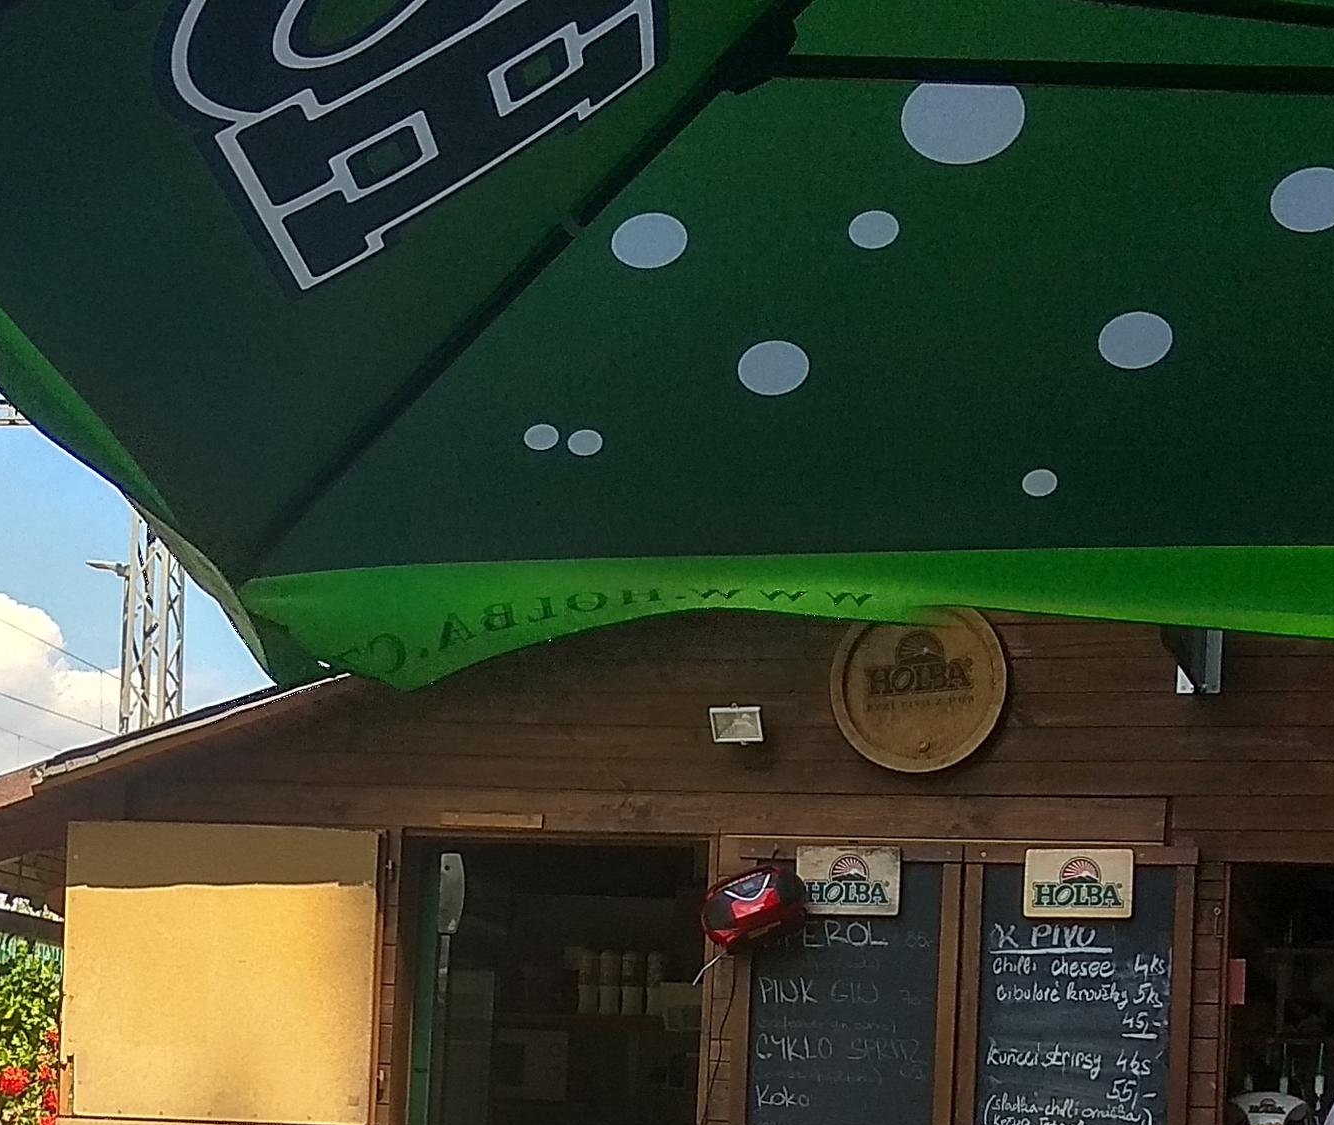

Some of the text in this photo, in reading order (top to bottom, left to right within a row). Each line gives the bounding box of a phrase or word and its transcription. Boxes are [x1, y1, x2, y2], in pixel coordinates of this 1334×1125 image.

[804, 880, 890, 905] HOLBA
[1032, 880, 1122, 909] HOLBA
[799, 919, 889, 949] EROL
[1031, 923, 1097, 949] PIVU
[757, 976, 819, 1005] PINK
[755, 1032, 834, 1062] CYKLO
